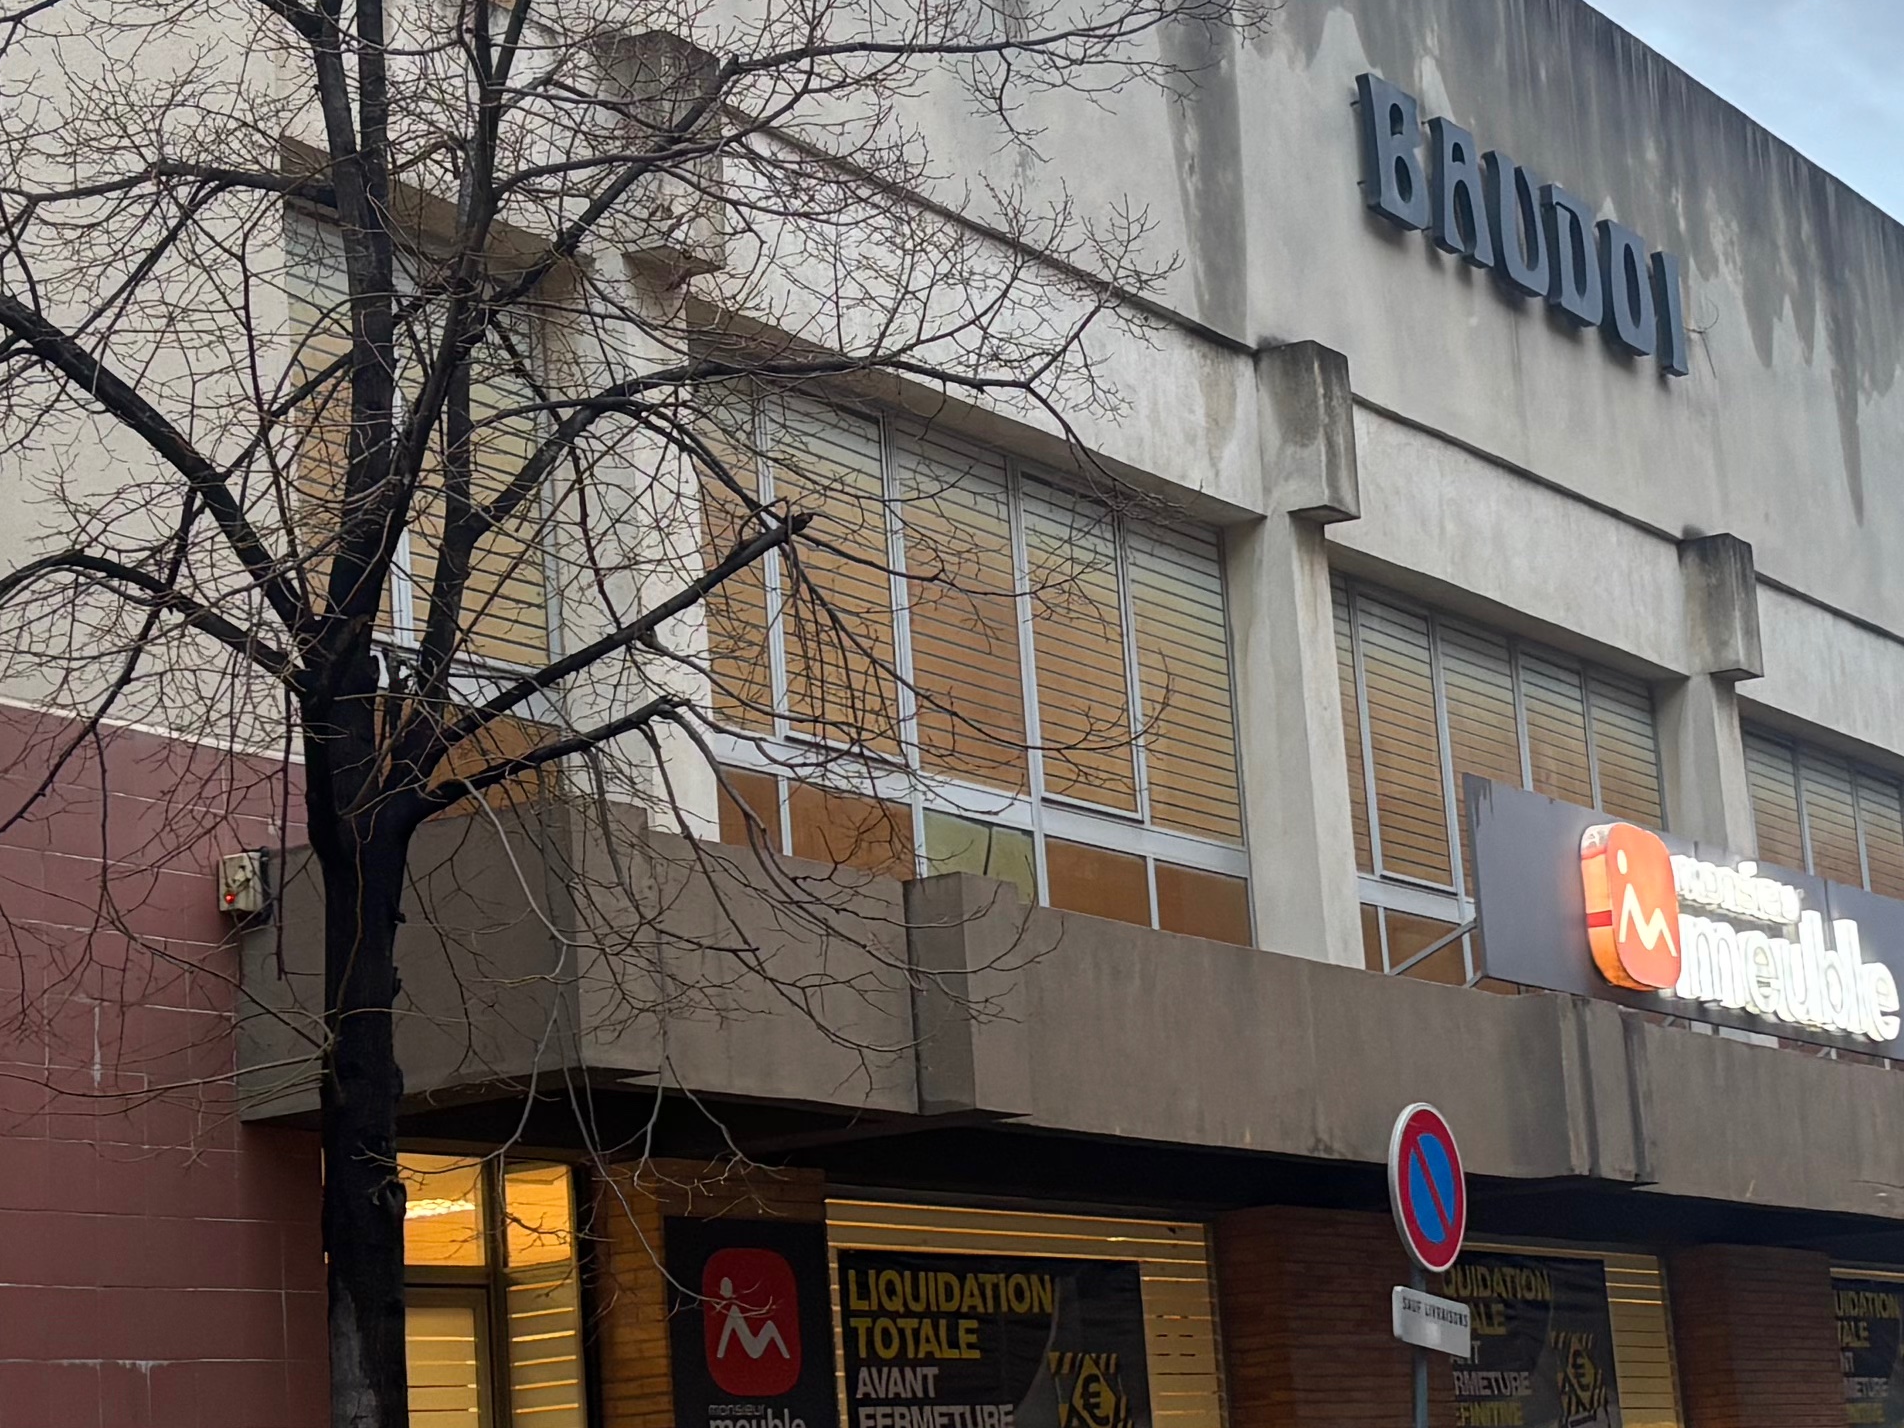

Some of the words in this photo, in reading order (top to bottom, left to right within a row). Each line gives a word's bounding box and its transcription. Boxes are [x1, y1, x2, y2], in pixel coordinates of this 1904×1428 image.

[1675, 909, 1901, 1043] meuble
[847, 1268, 1055, 1314] LIQUIDATION
[849, 1317, 982, 1360] TOTALE
[855, 1366, 940, 1399] AVANT
